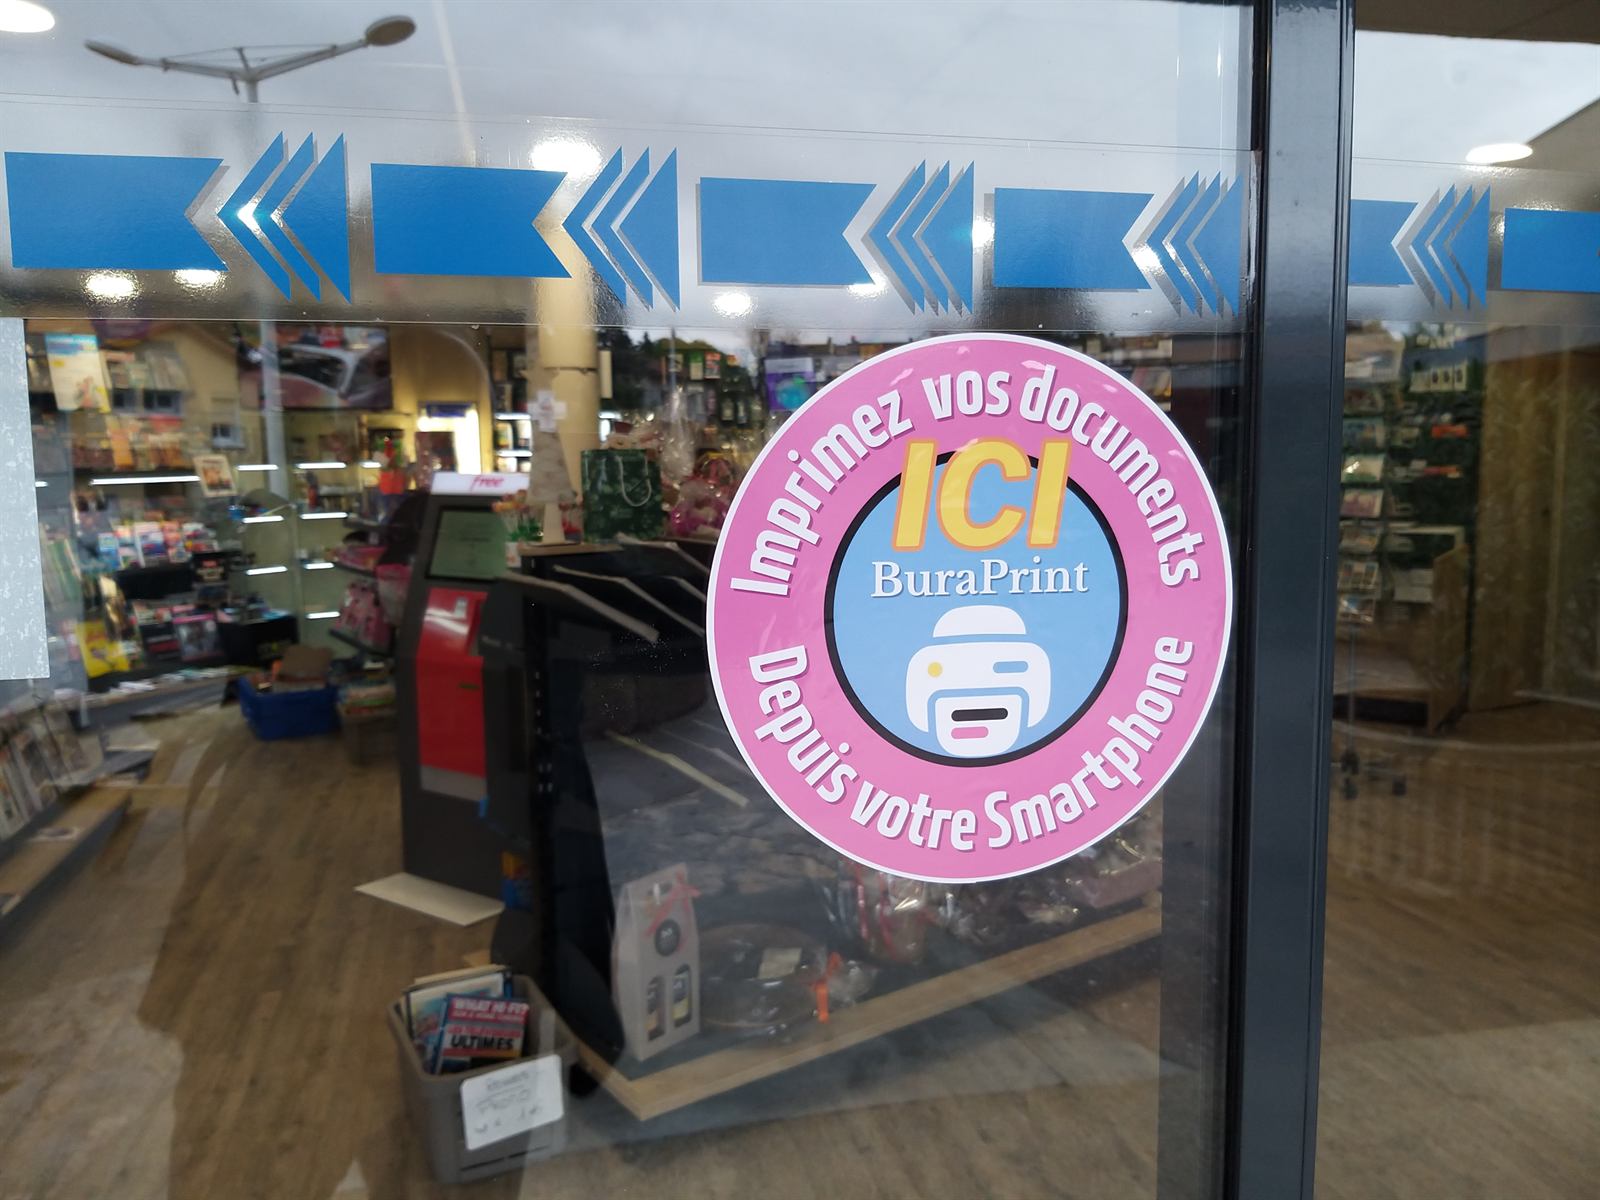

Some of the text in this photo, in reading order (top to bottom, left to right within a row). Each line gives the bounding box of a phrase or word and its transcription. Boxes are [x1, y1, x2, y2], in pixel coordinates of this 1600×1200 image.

[730, 364, 1206, 596] Imprimez vos documents
[892, 438, 1071, 552] ICI
[871, 556, 1090, 599] BuraPrint
[748, 635, 1194, 851] Depuis votre Smartphone
